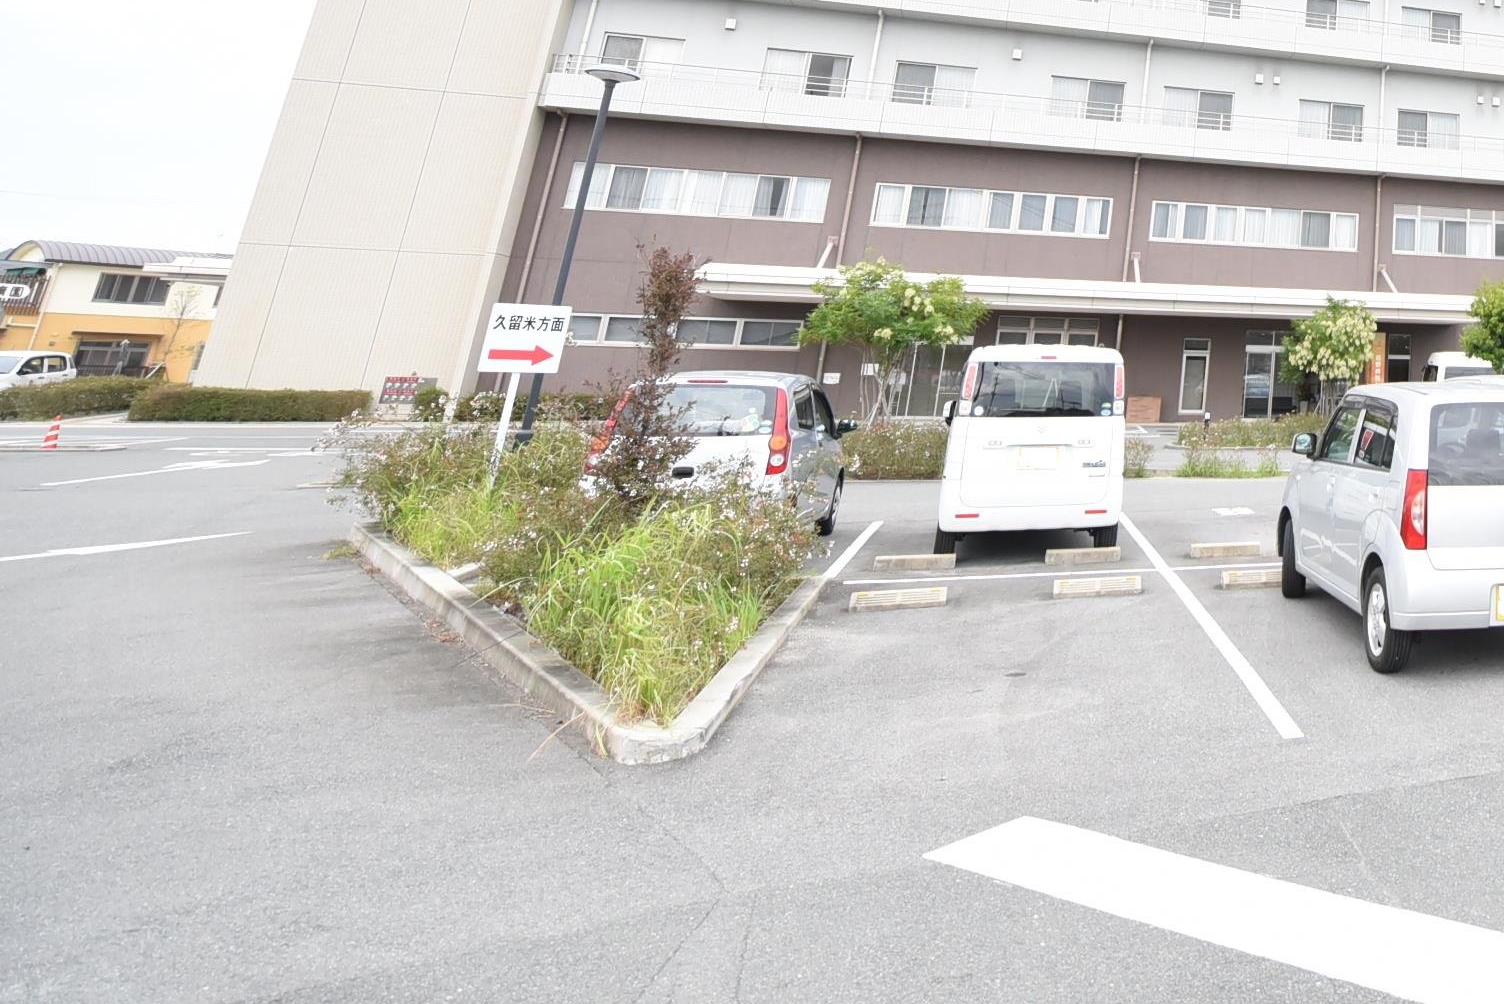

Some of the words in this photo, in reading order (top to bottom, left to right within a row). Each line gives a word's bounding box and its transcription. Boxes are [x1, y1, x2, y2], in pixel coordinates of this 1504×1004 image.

[493, 314, 566, 332] 久留米方面
